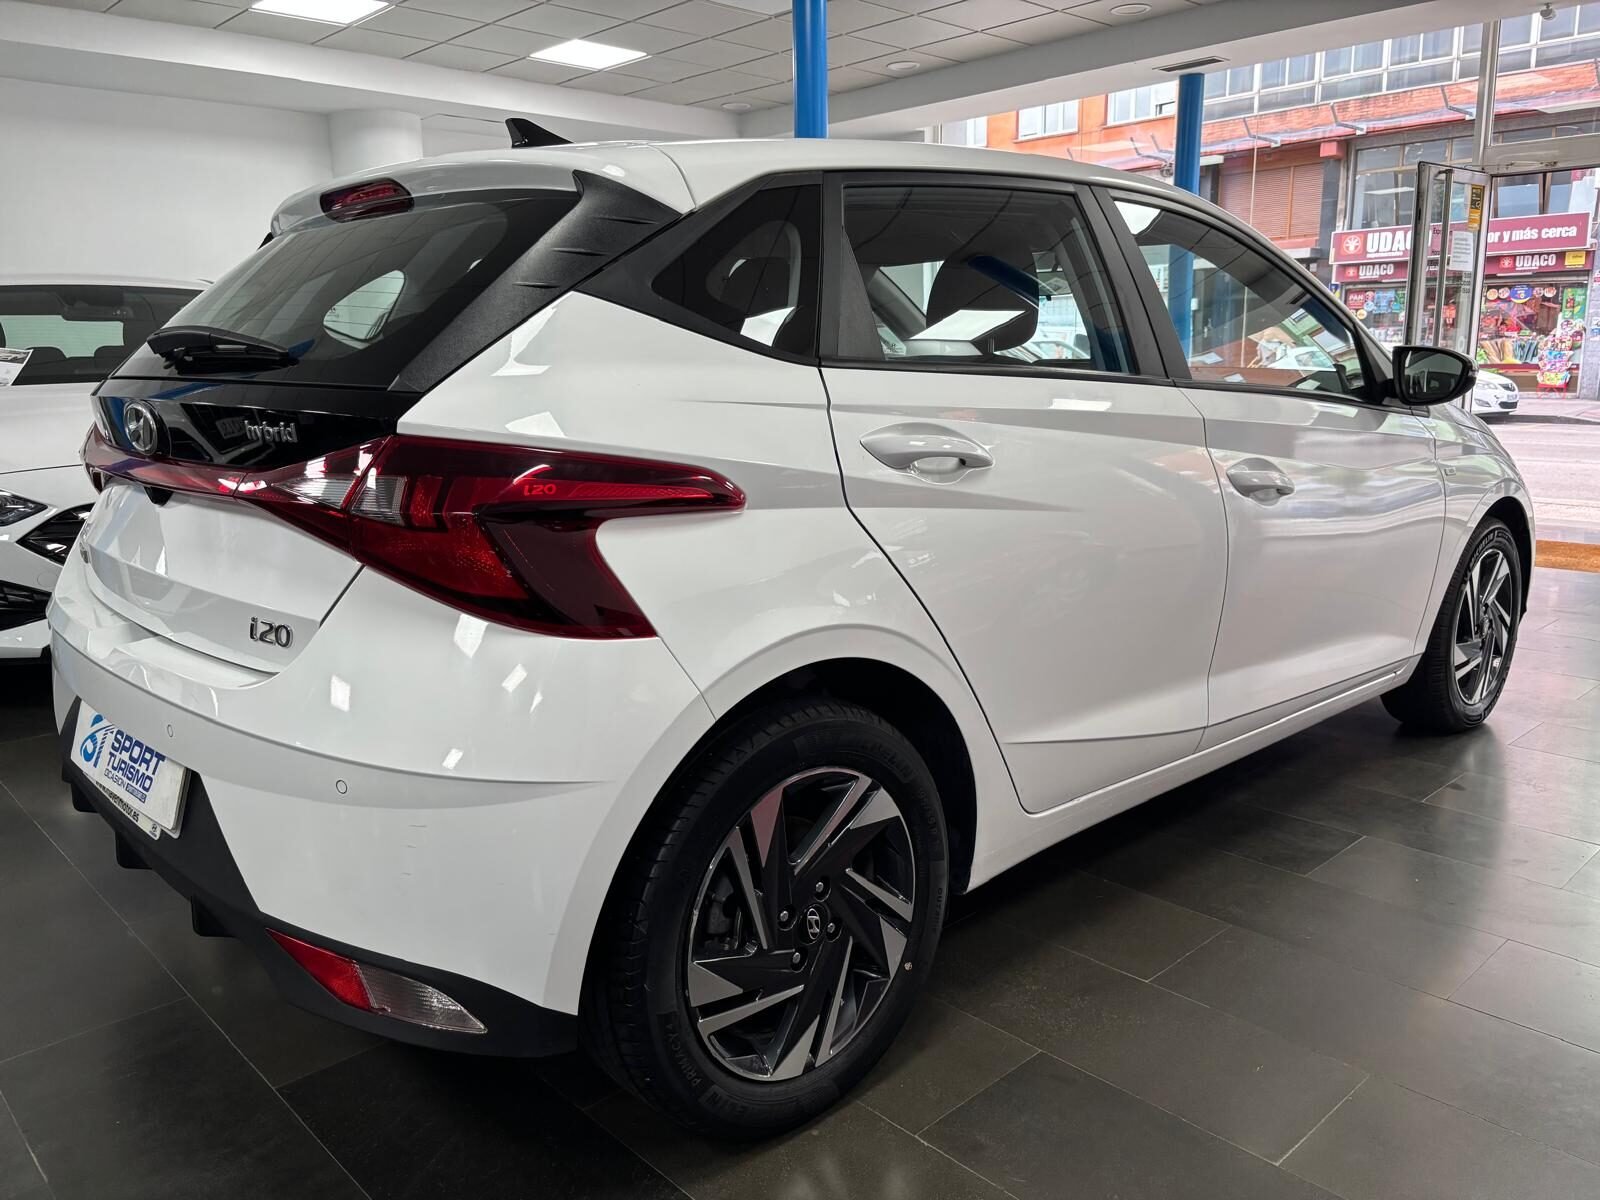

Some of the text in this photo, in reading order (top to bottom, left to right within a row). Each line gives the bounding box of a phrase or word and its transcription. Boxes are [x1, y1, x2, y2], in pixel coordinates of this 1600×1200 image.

[1366, 229, 1433, 253] UDA
[1503, 230, 1511, 243] y
[1511, 226, 1538, 241] más
[1541, 225, 1577, 239] cerca
[1359, 263, 1394, 276] UDACO
[1515, 253, 1556, 267] UDACO
[244, 419, 298, 442] hybrid
[249, 616, 293, 648] i20
[111, 729, 166, 775] SPORT
[107, 751, 154, 793] TURISMO
